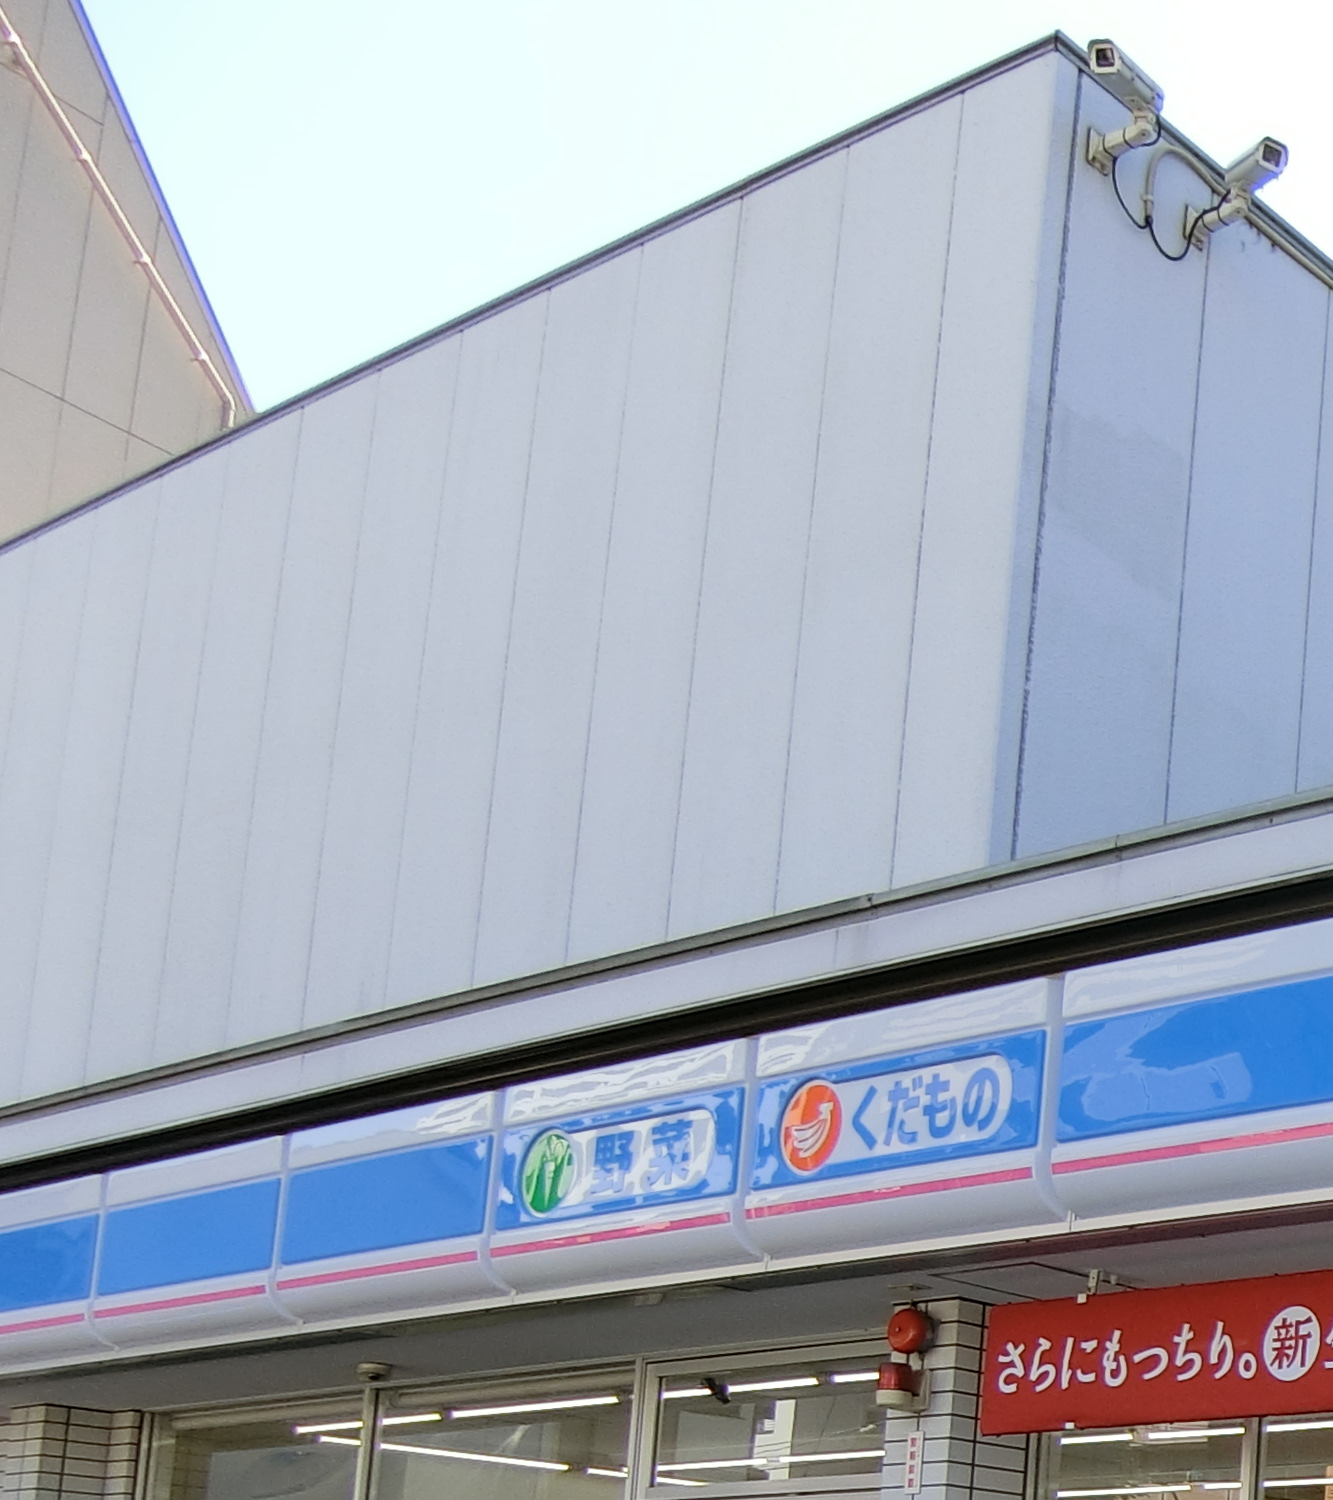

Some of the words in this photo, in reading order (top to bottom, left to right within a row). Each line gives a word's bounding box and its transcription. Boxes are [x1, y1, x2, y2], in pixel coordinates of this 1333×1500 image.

[850, 1066, 1001, 1151] くだもの
[589, 1117, 694, 1196] 野菜
